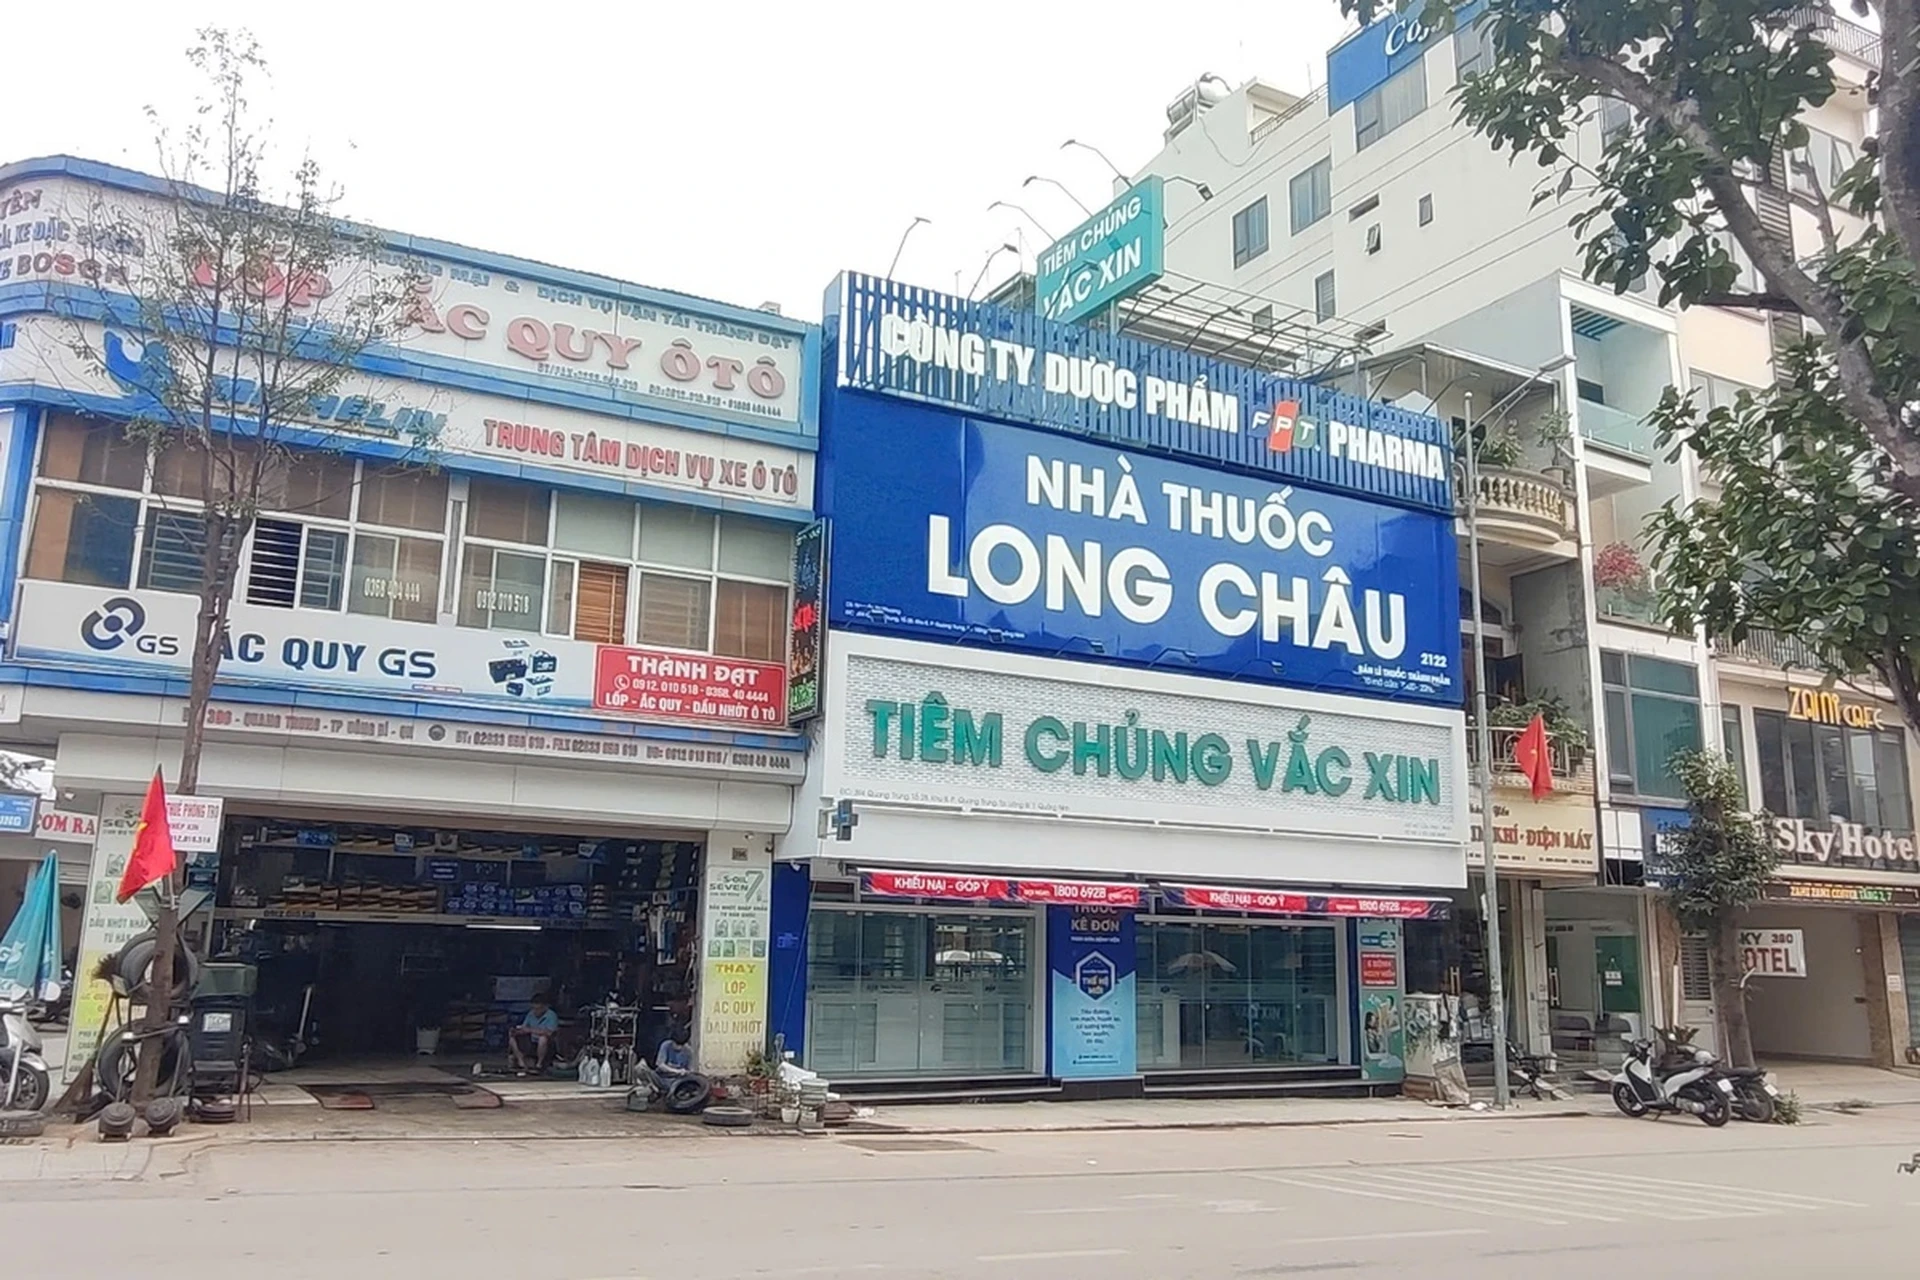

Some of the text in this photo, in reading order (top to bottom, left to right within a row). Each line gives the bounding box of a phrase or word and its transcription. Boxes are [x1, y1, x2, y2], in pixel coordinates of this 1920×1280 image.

[1043, 239, 1077, 277] TIÊM
[1098, 237, 1141, 291] XIN
[506, 316, 643, 370] QUY
[880, 313, 1445, 481] CÔNG TY DƯỢC PHẨM FPT PHARMA
[482, 418, 565, 458] TRUNG
[570, 430, 620, 467] TÂM
[625, 444, 680, 478] DỊCH
[685, 453, 715, 488] VỤ
[718, 460, 749, 487] XE
[1025, 453, 1336, 559] NHÀ THUỐC
[927, 514, 1407, 660] LONG CHÂU
[136, 633, 179, 657] GS
[282, 637, 367, 673] QUY
[377, 648, 437, 680] GS
[627, 655, 760, 687] THÀNH ĐẠT
[1420, 651, 1448, 669] 2122
[659, 698, 683, 713] QUY
[865, 690, 1004, 769] TIÊM
[1024, 708, 1233, 786] CHỦNG
[1246, 713, 1352, 797] VẮC
[1363, 751, 1442, 805] XIN
[1525, 826, 1560, 851] ĐIỆN
[1563, 828, 1593, 850] MÁY
[1776, 817, 1920, 862] Sky Hote
[709, 883, 748, 891] SEVEN
[894, 873, 925, 889] KHIẾU
[927, 878, 946, 894] NẠI
[955, 879, 980, 893] GÓP
[1052, 884, 1076, 898] 1800
[1080, 886, 1106, 899] 6928
[1070, 916, 1120, 932] KÊ ĐƠN
[715, 964, 756, 973] THAY
